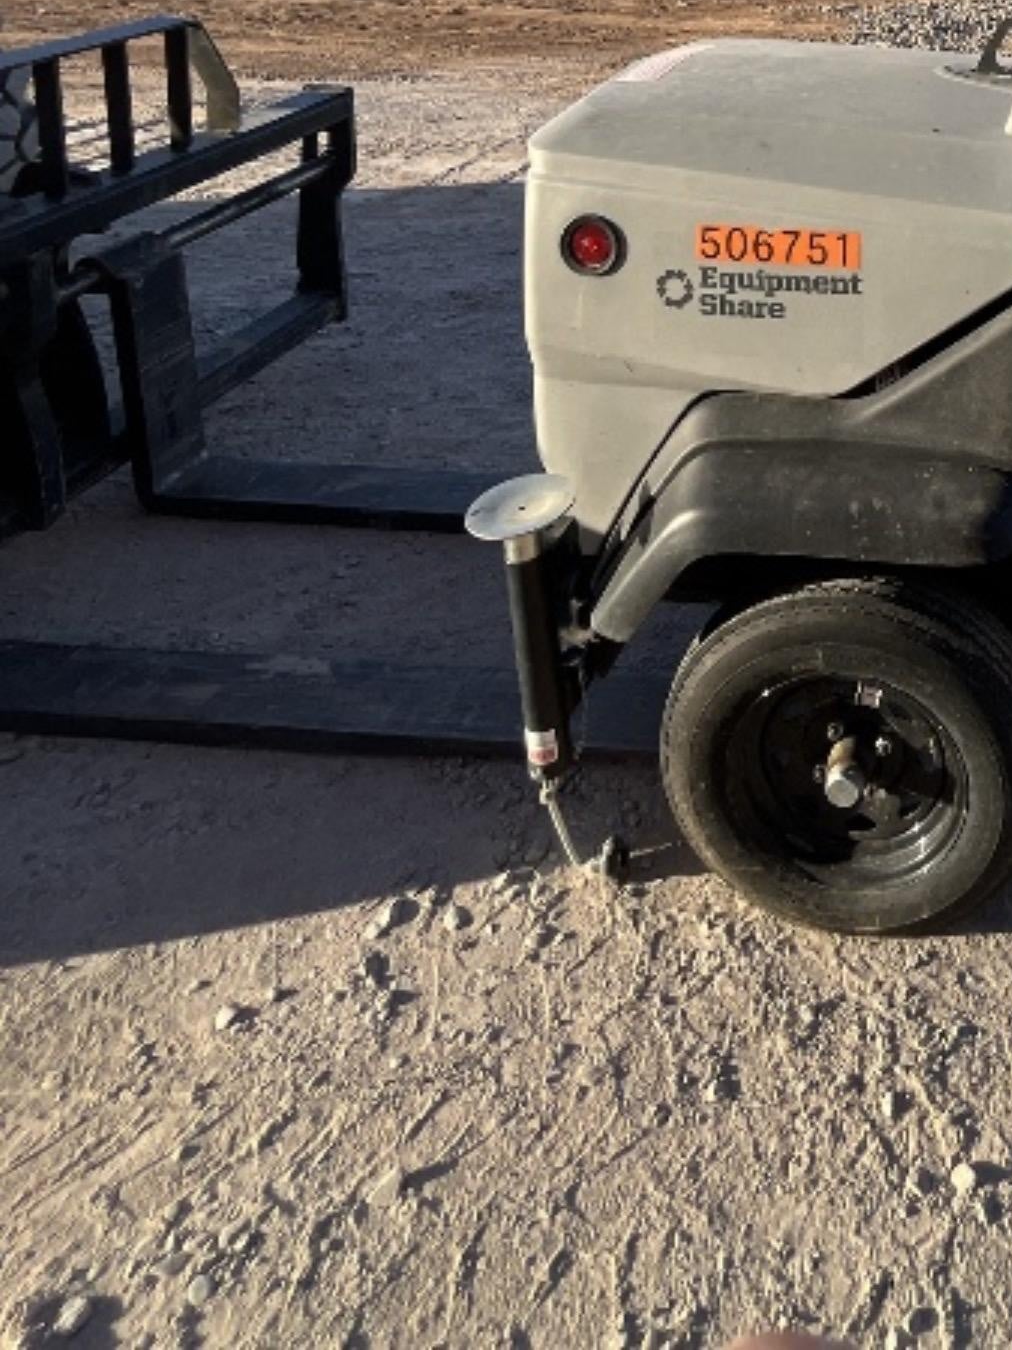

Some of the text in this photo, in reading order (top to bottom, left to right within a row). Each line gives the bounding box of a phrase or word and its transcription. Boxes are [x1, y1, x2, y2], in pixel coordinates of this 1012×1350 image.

[700, 226, 849, 267] 506751
[698, 266, 863, 297] Equipment
[698, 294, 786, 319] Share
